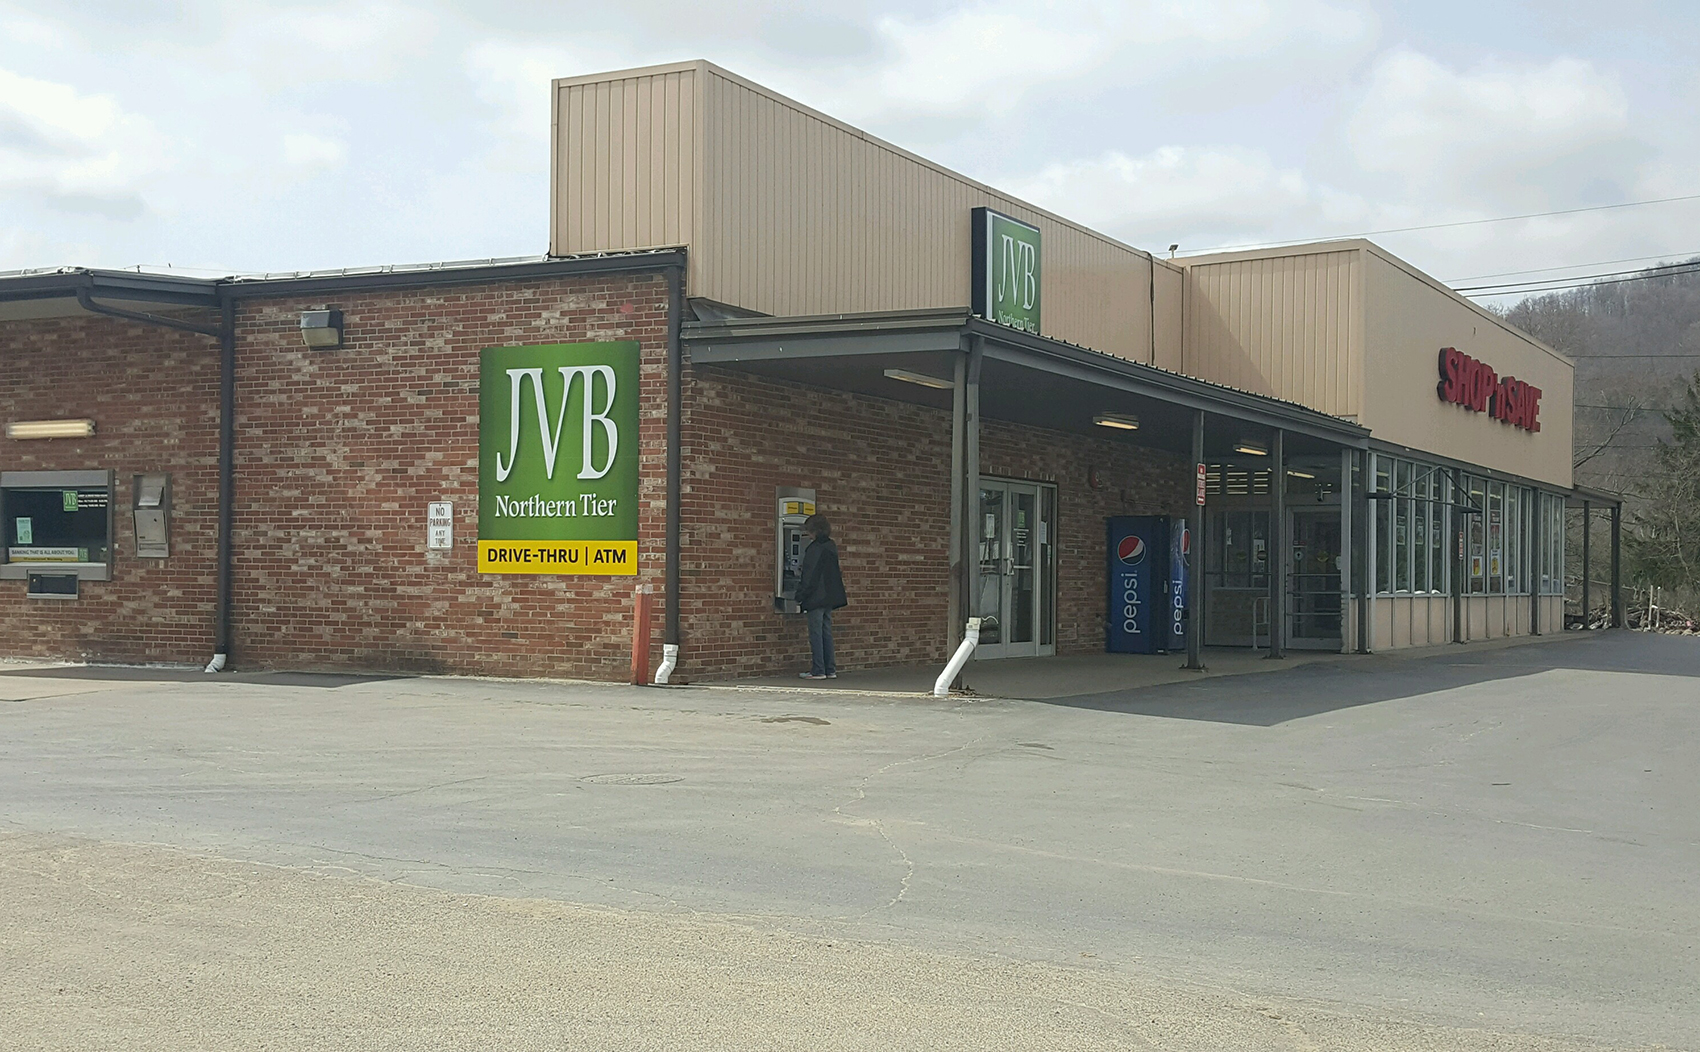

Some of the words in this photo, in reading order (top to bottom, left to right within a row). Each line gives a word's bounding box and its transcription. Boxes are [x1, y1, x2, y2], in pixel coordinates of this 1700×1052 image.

[998, 234, 1036, 310] JVB
[1437, 347, 1495, 413] SHOP
[1501, 376, 1542, 433] SAVE
[496, 365, 619, 482] JVB
[429, 518, 451, 527] PARKING
[435, 507, 445, 517] NO
[495, 493, 577, 518] Northern
[579, 493, 617, 517] Tier
[487, 548, 579, 563] DRIVE-THRU
[593, 549, 627, 563] ATM
[1121, 572, 1141, 634] pepsi
[1172, 580, 1184, 635] pepsi
